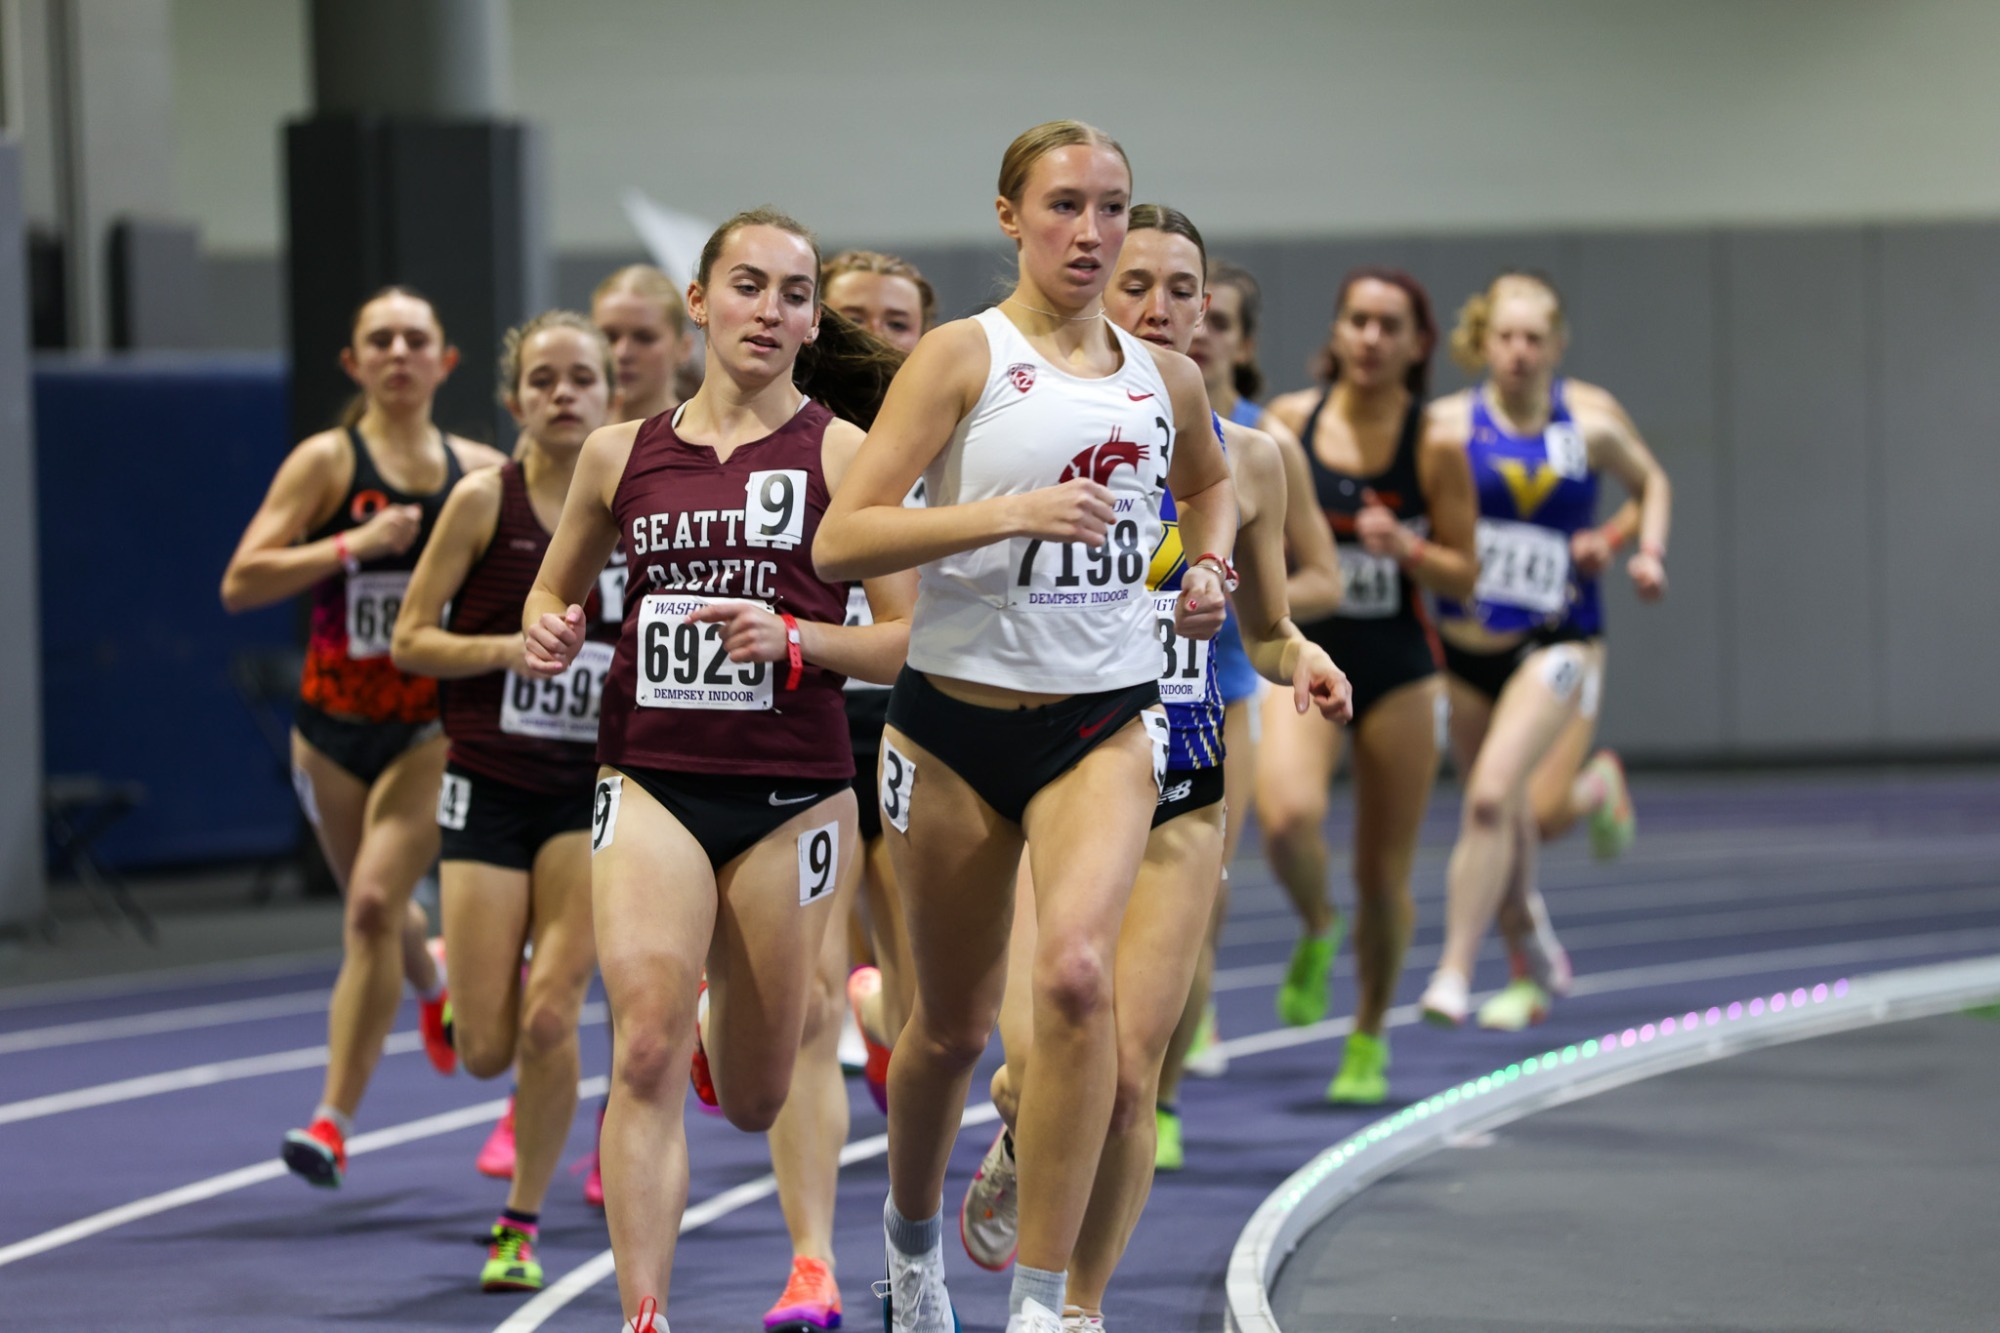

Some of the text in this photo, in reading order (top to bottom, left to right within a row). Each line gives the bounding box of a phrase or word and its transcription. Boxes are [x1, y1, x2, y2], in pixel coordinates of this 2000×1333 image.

[1155, 416, 1170, 490] 3
[633, 509, 794, 556] SEATT
[760, 473, 794, 537] 9
[647, 559, 778, 599] PACIFIC
[1017, 519, 1144, 587] 7198
[1029, 589, 1129, 604] DEMPSEY INDOOR
[513, 667, 608, 720] 659
[653, 688, 754, 702] DEMPSEY INDOOR
[593, 782, 611, 850] 9
[884, 750, 903, 819] 3
[809, 830, 832, 898] 9
